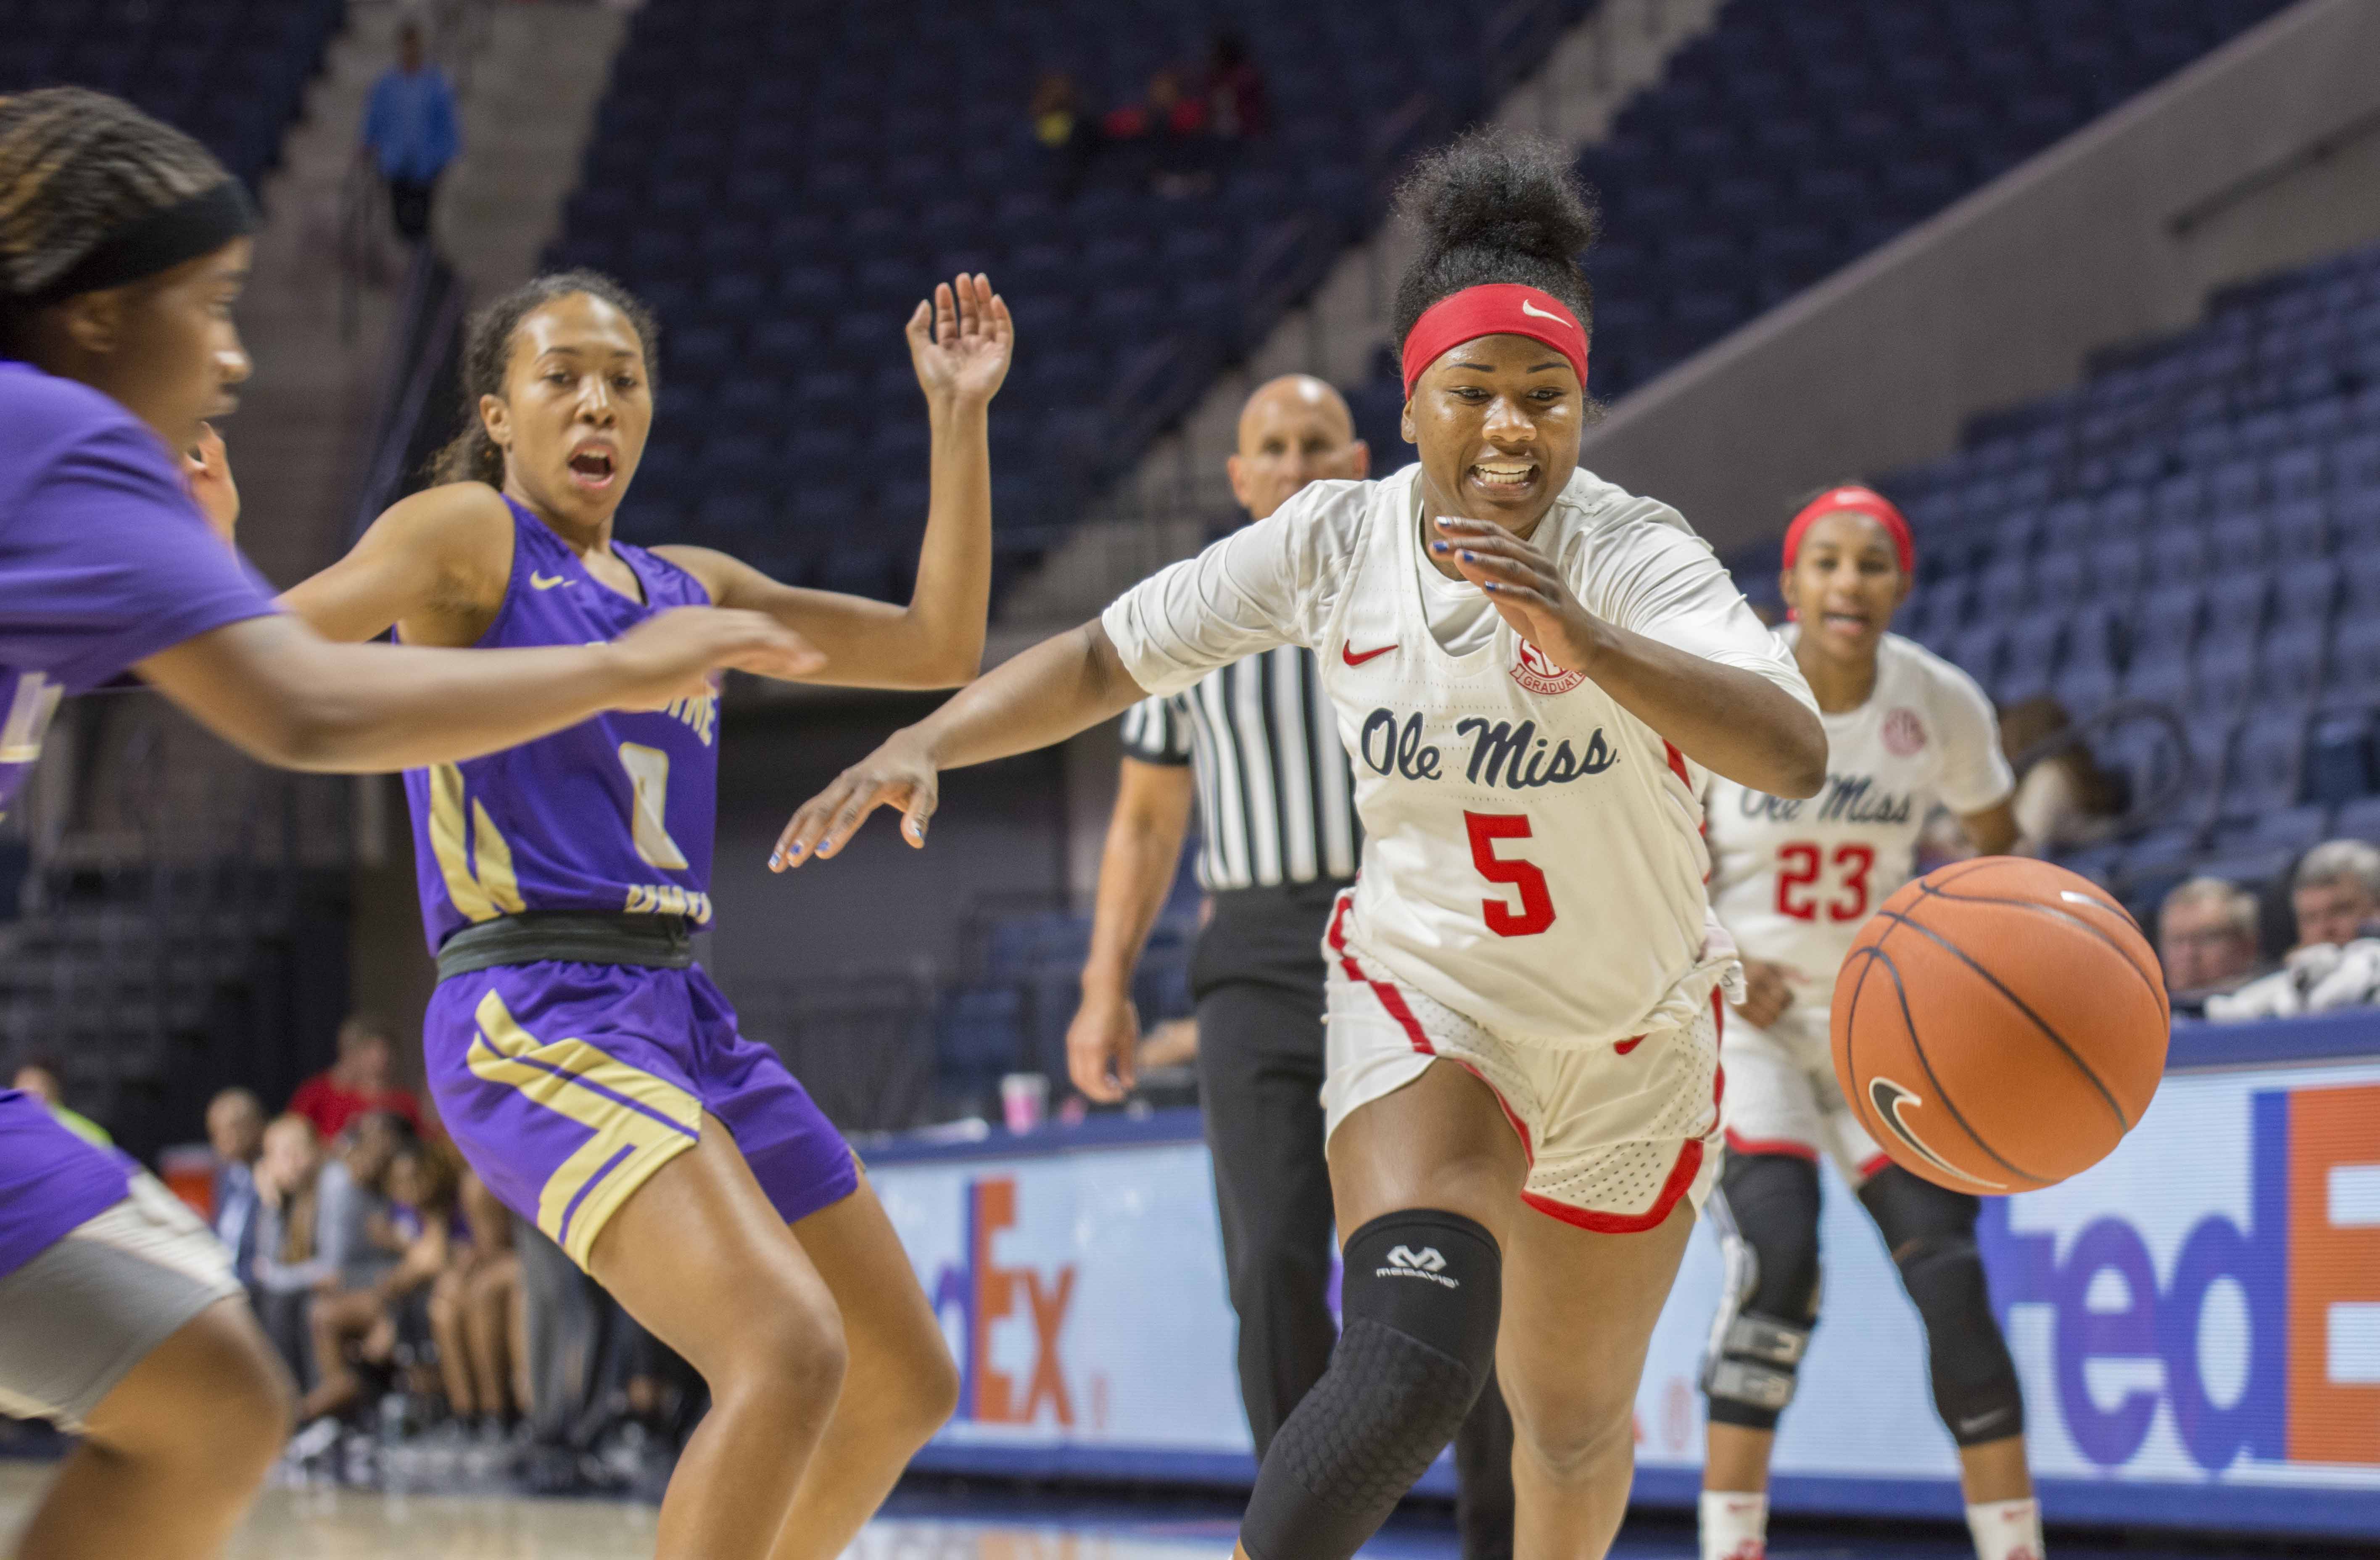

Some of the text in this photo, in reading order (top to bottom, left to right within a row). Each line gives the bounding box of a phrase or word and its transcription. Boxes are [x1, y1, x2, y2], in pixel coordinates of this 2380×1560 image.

[1361, 707, 1442, 781] Ole
[1818, 773, 1911, 824] Miss
[1463, 810, 1556, 937] 5
[1775, 842, 1875, 921] 23
